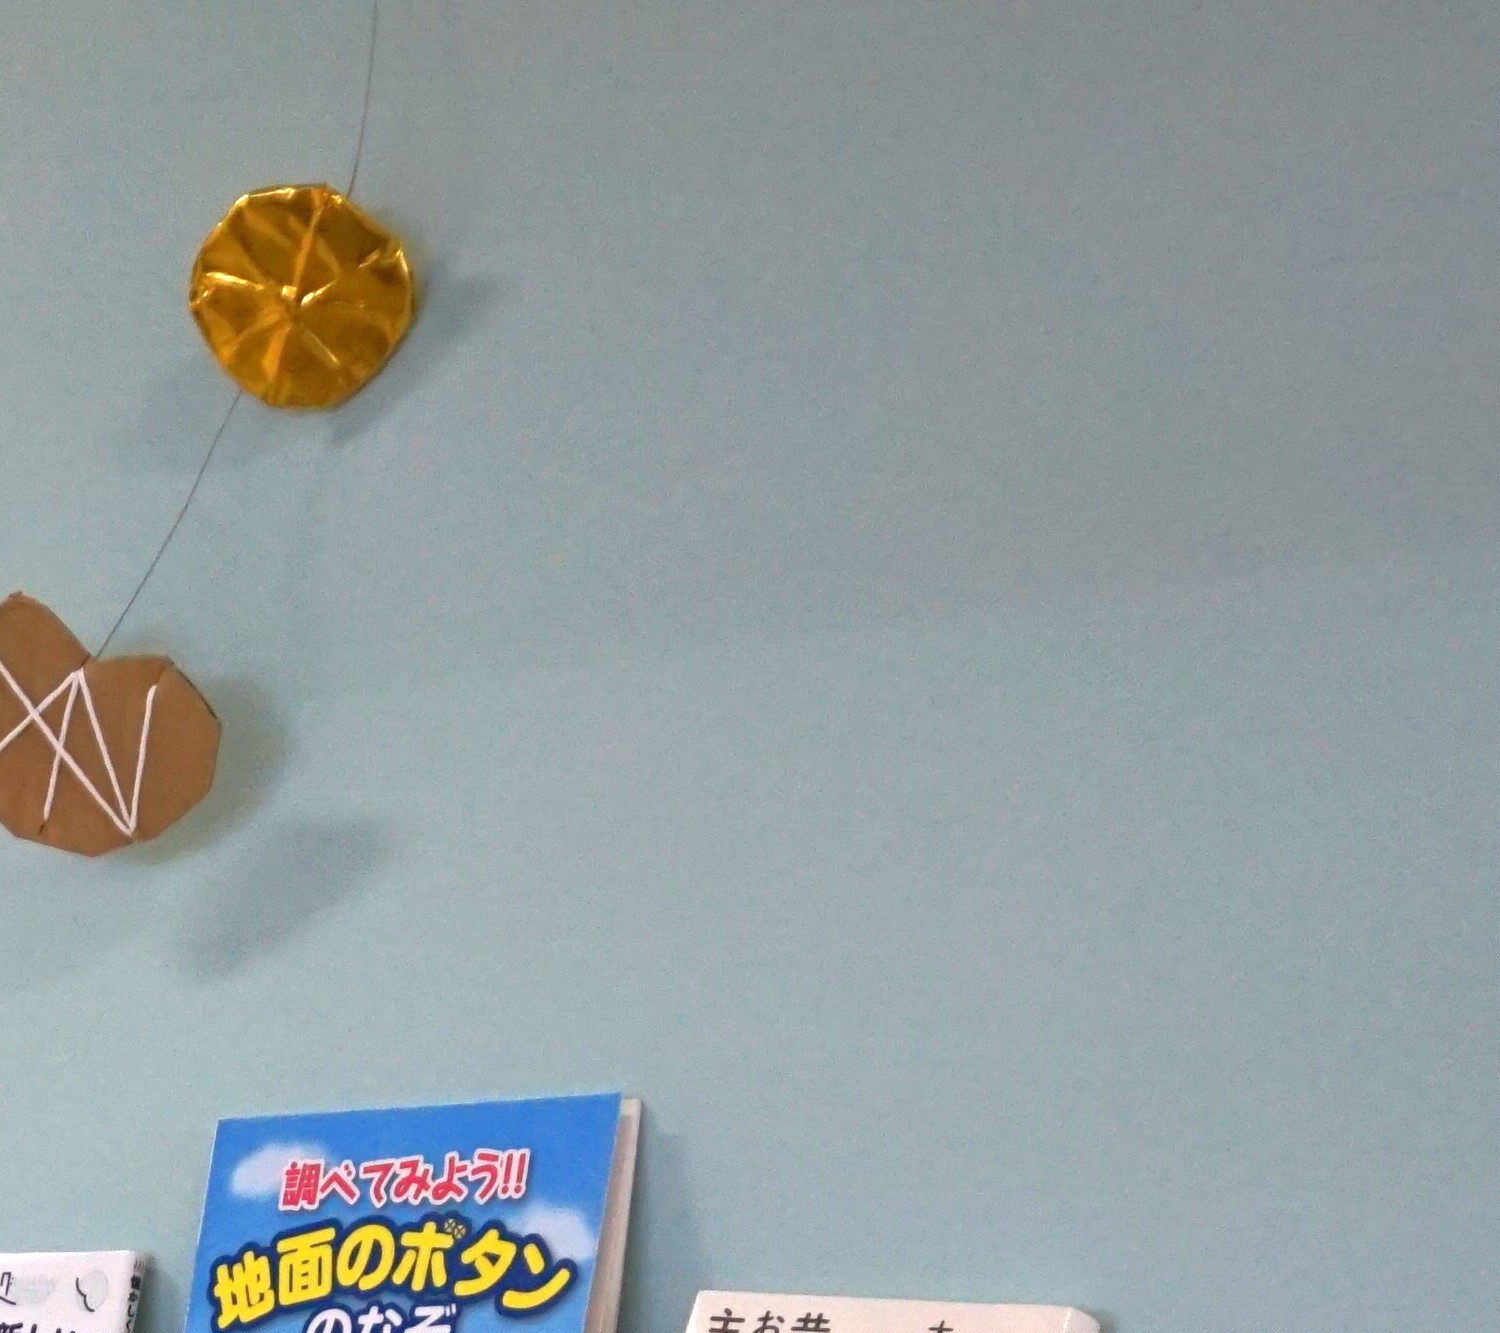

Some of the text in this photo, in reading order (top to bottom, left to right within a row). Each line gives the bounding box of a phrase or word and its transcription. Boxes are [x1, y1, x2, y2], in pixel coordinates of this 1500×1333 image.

[280, 1149, 531, 1210] 調べてみよう!!
[212, 1217, 572, 1331] 地面のボタン
